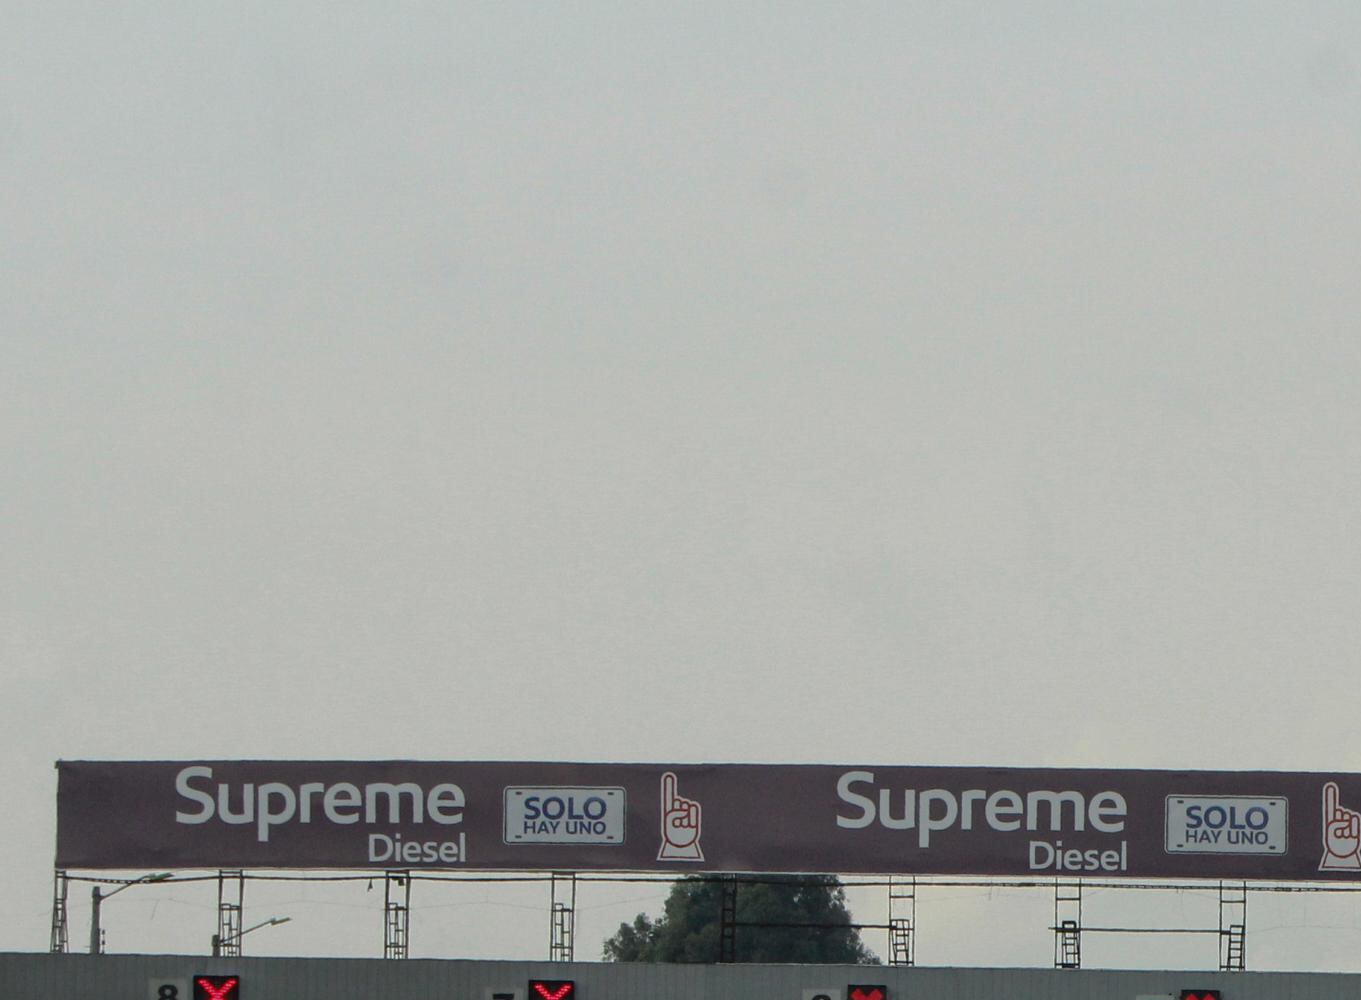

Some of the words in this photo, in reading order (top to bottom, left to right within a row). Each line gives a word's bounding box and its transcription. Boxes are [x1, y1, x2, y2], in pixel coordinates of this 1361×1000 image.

[175, 766, 465, 842] Supreme
[524, 796, 607, 820] SOLO
[836, 771, 1128, 848] Supreme
[1186, 805, 1269, 830] SOLO
[523, 821, 560, 834] HAY
[566, 821, 606, 835] UNO
[1185, 829, 1222, 844] HAY
[1227, 830, 1268, 845] UNO
[368, 832, 466, 862] Diesel
[1028, 840, 1127, 871] Diesel
